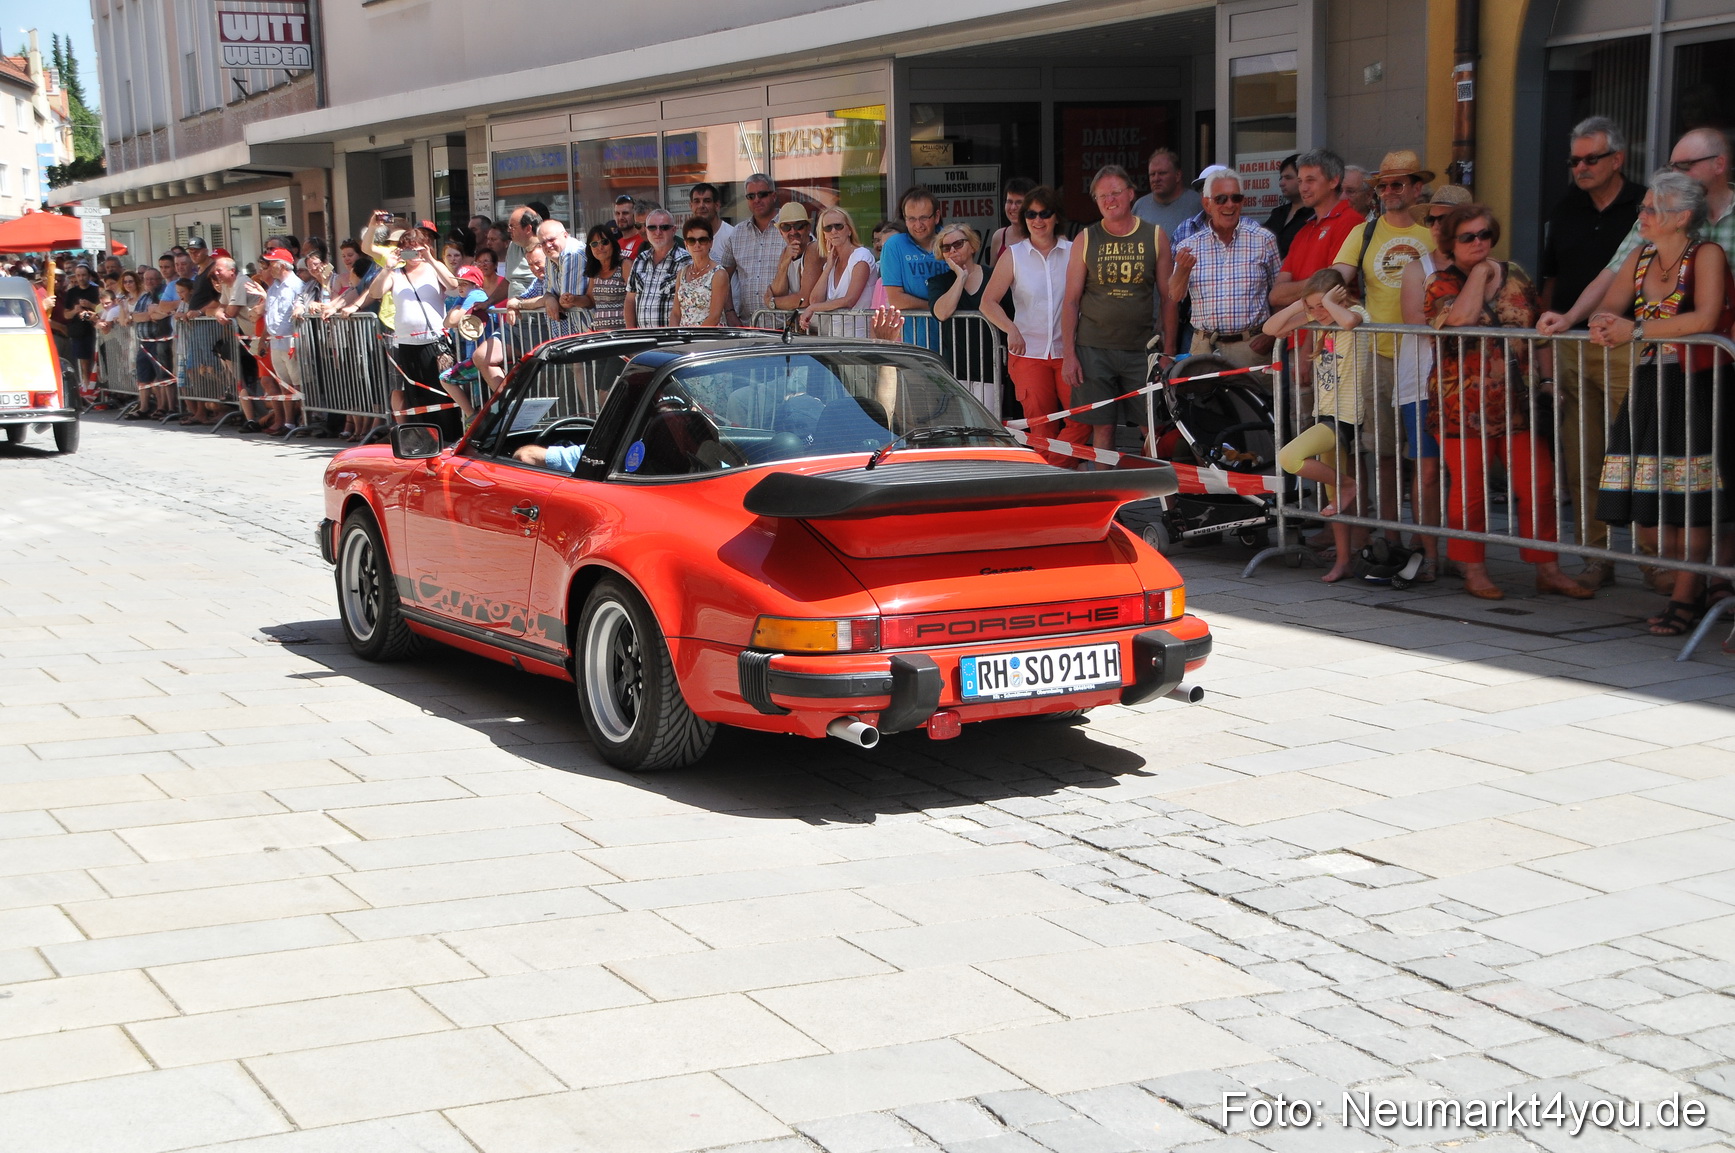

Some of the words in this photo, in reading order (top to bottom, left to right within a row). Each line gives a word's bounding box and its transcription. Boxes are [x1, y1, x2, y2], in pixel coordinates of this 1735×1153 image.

[221, 13, 305, 42] WITT
[223, 46, 310, 66] WEIDEN
[1081, 128, 1147, 146] DANKE-
[624, 158, 651, 174] TOTAL
[1239, 160, 1281, 173] NACHLÄS
[945, 171, 968, 181] TOTAL
[1252, 178, 1270, 190] ALLES
[952, 199, 994, 217] ALLES
[1138, 242, 1144, 253] 6
[14, 394, 28, 405] 95
[979, 565, 1036, 576] Carrera
[414, 571, 547, 639] Carrera
[917, 606, 1119, 638] PORSCHE
[978, 659, 1009, 690] RH
[966, 680, 974, 690] D
